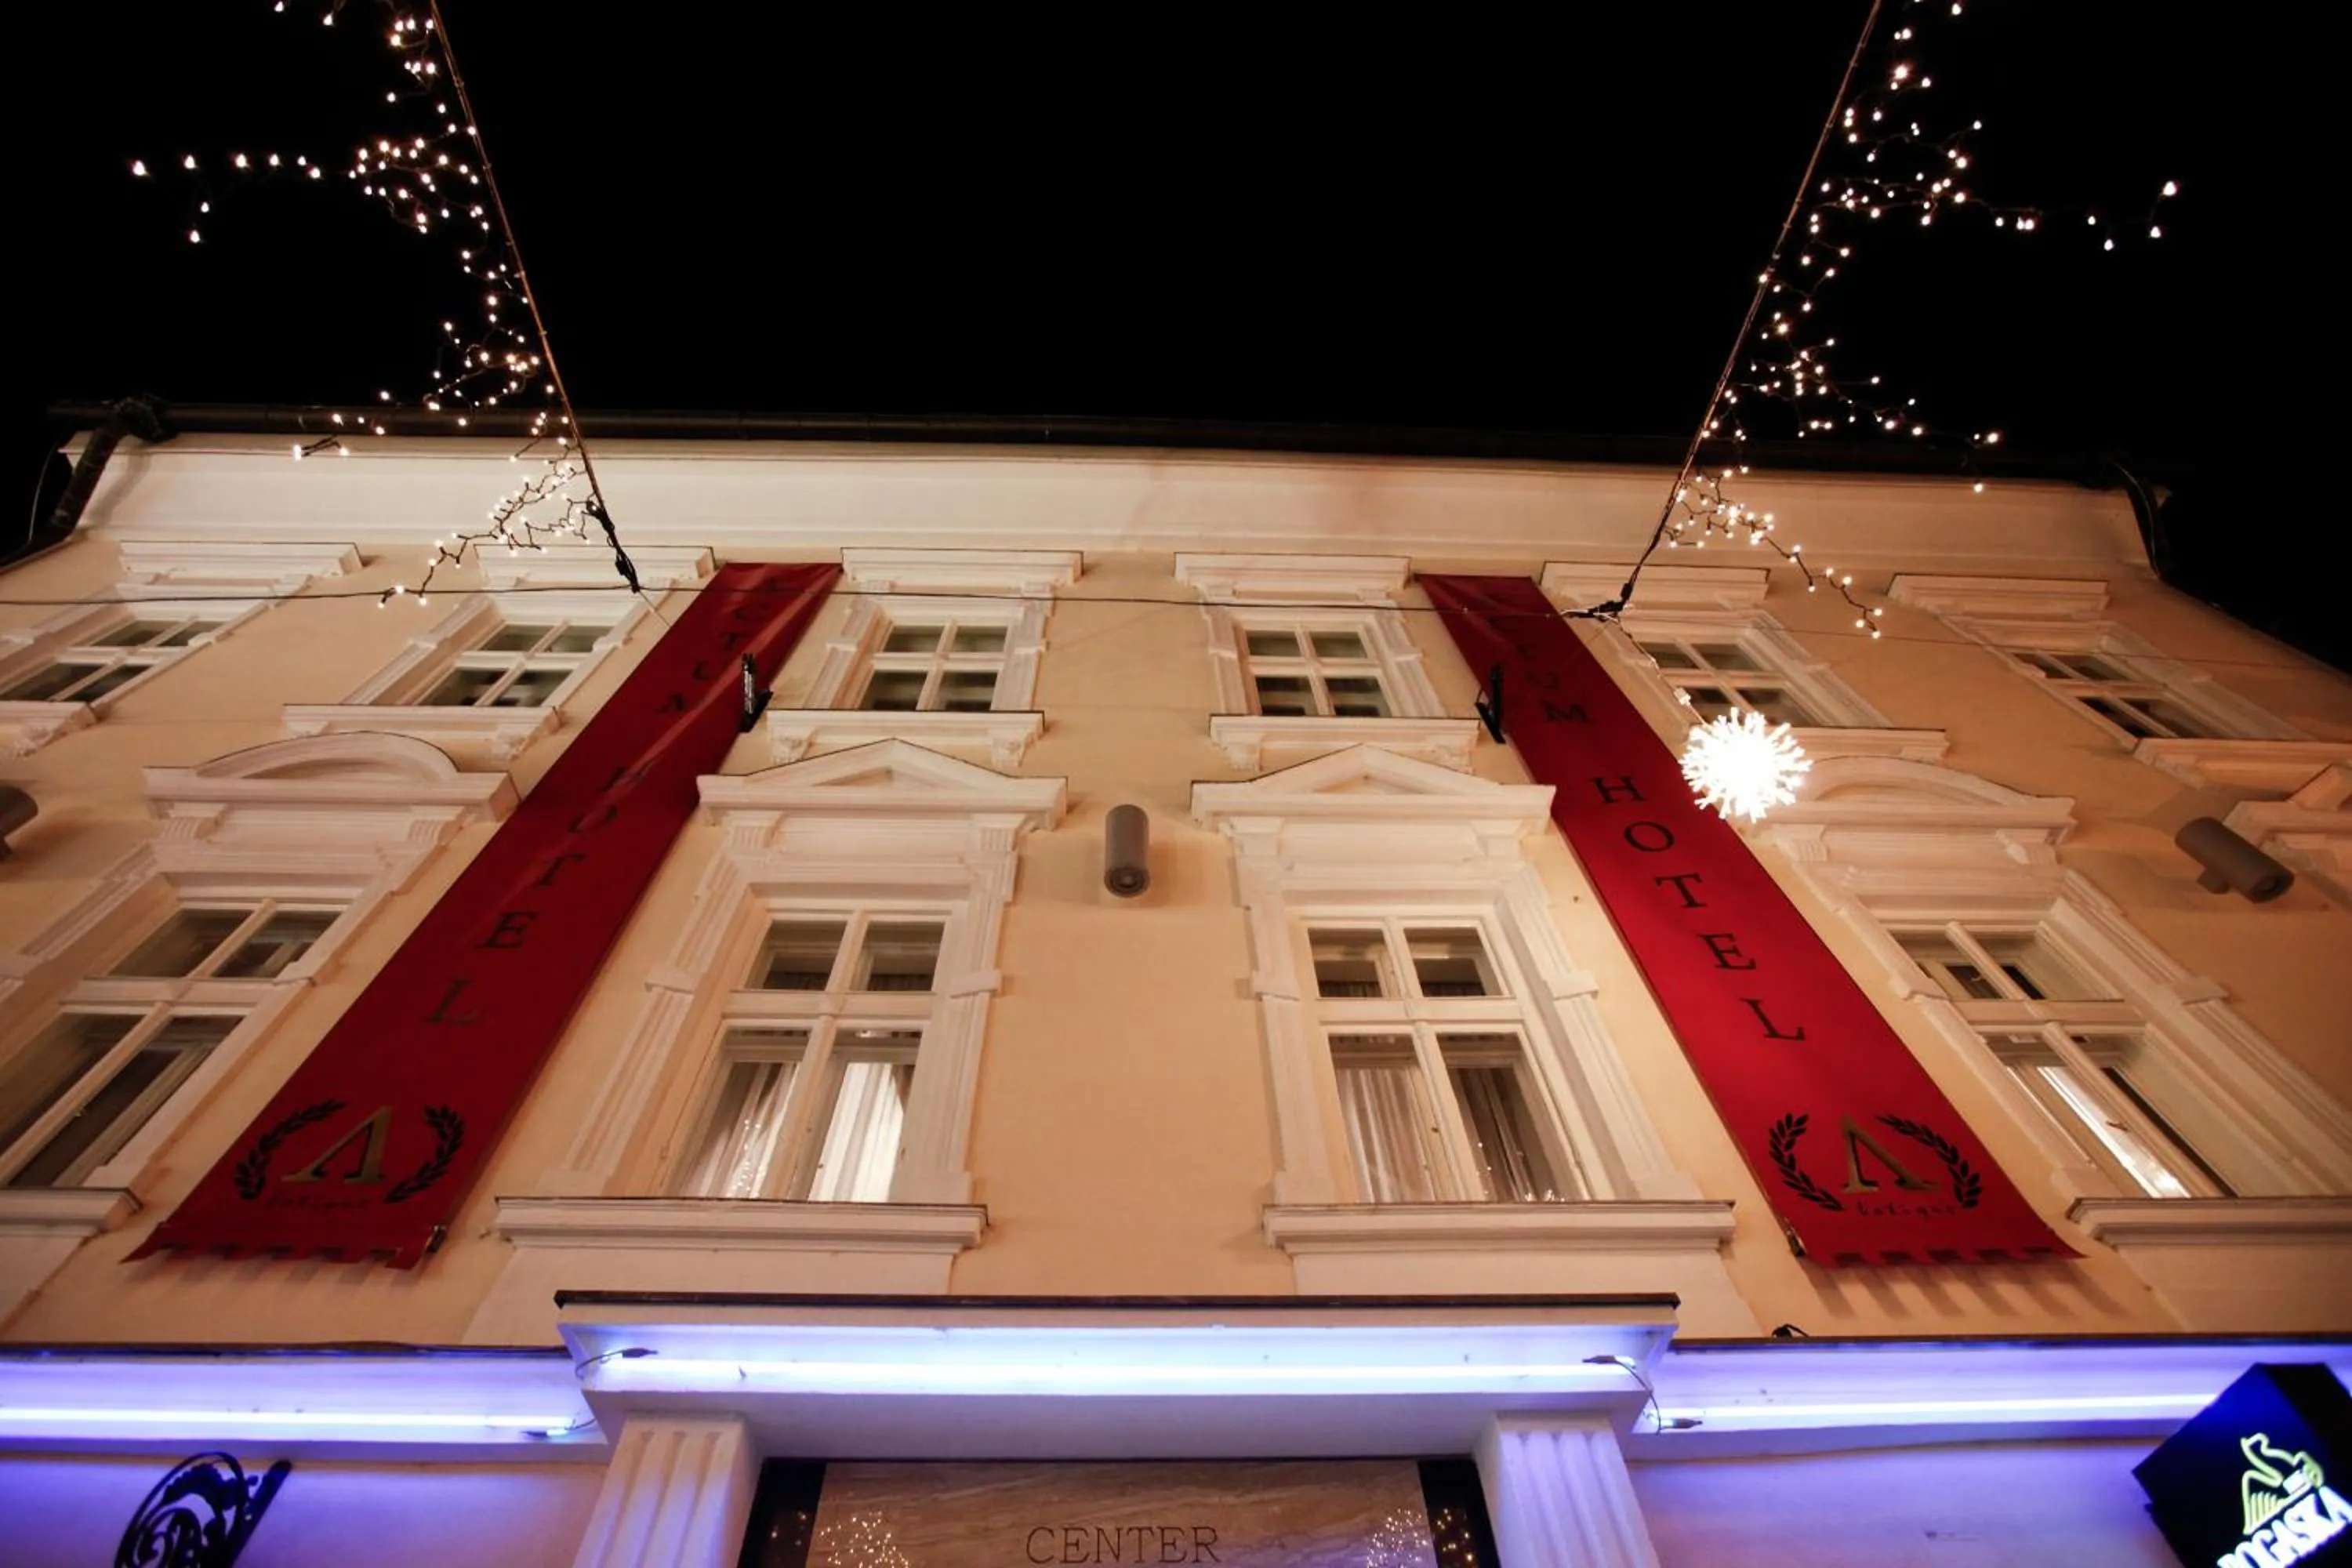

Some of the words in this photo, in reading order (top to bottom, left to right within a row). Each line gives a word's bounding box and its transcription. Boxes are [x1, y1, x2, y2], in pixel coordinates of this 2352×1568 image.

[1590, 775, 1807, 1042] HOTEL
[1025, 1526, 1222, 1564] CENTER
[2216, 1486, 2352, 1568] OGASKA
